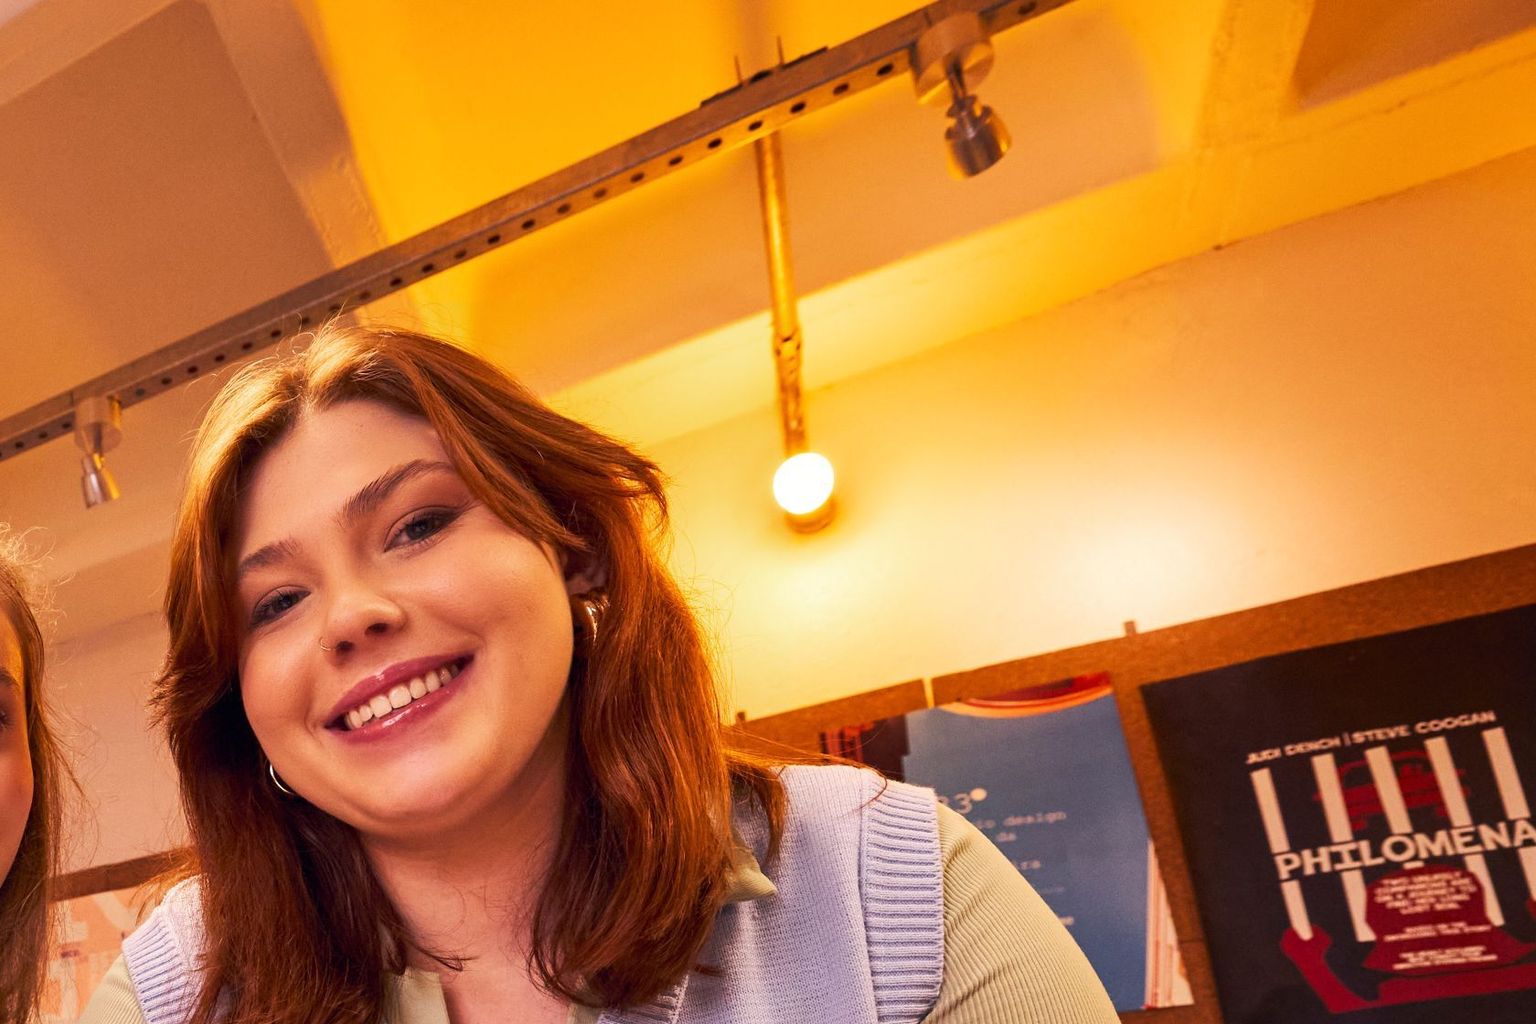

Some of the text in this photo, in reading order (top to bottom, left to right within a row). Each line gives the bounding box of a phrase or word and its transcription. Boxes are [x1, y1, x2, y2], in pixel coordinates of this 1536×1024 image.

[1246, 710, 1496, 764] JUDI DENCH STEVE COOGAN
[1274, 818, 1536, 881] PHILOMENA
